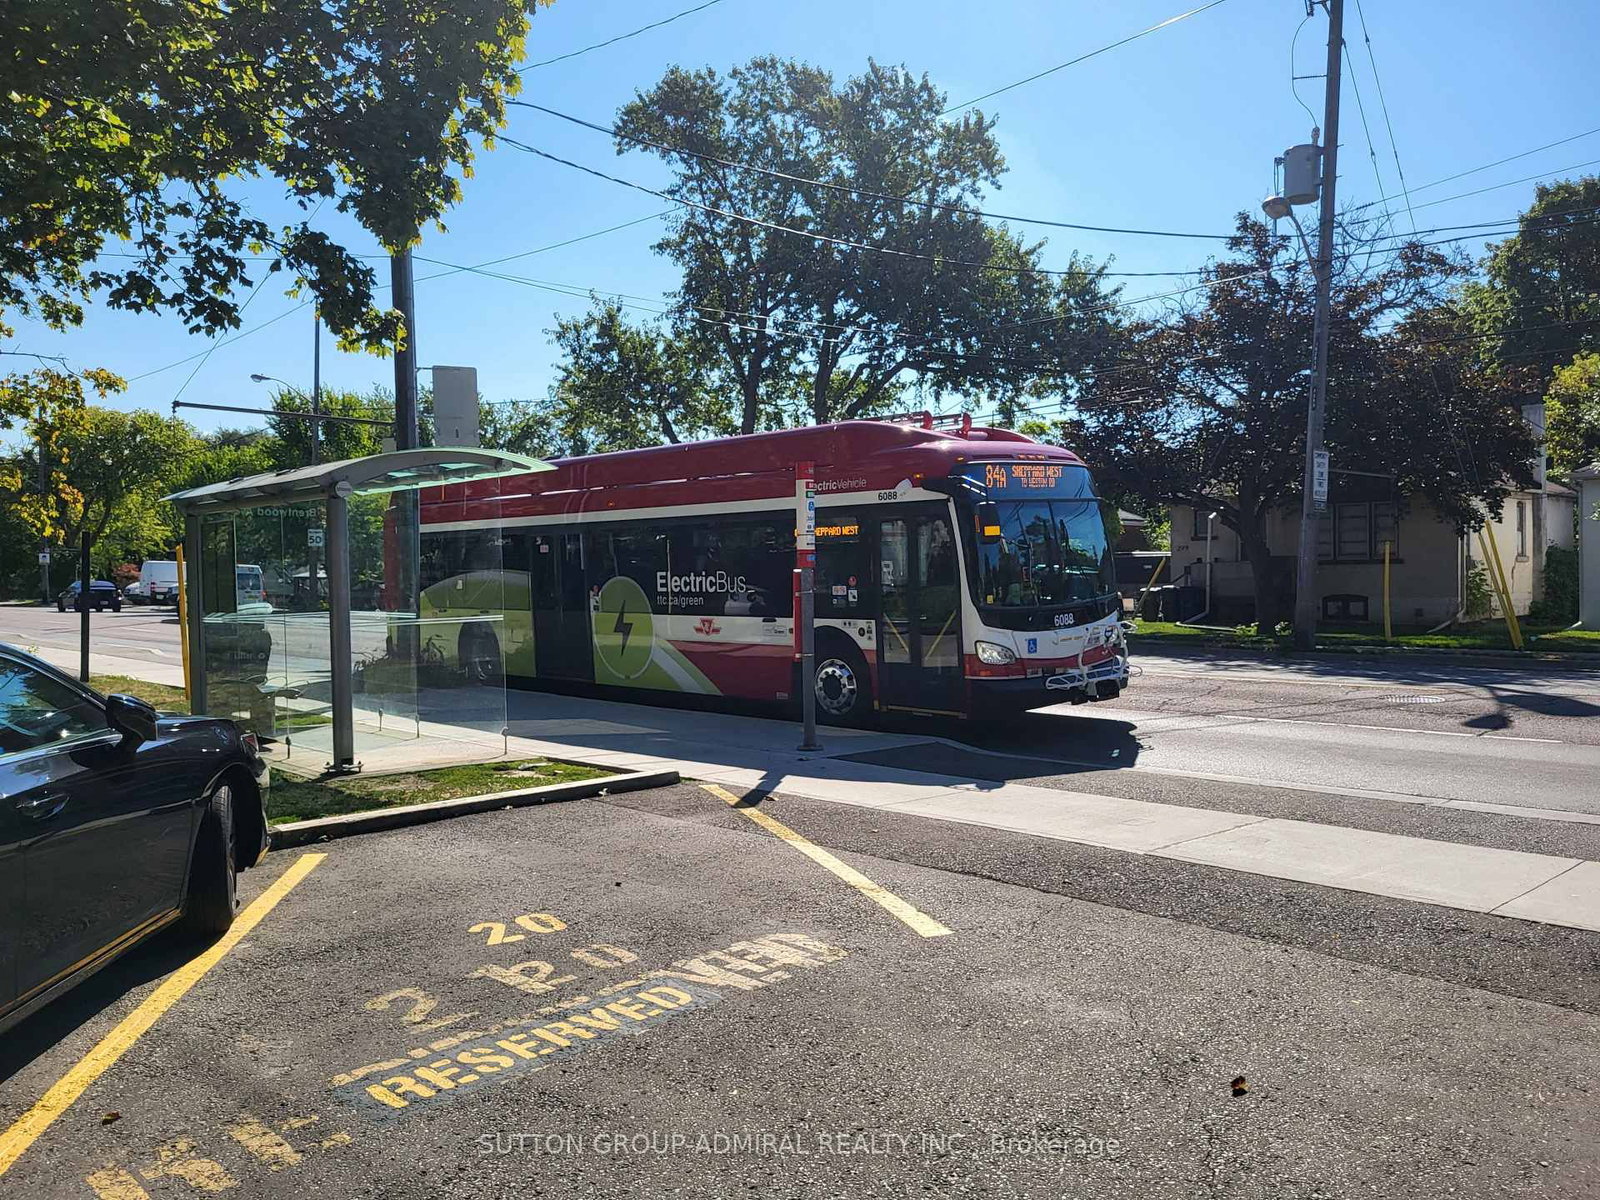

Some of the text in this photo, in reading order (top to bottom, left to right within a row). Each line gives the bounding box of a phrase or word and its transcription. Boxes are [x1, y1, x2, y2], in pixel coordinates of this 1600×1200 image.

[985, 464, 1063, 488] 84A SHEPPARD WEST
[813, 477, 867, 491] ectricVehicle
[878, 491, 898, 501] 6088
[842, 525, 859, 536] WEST
[309, 536, 322, 545] 50
[656, 570, 747, 593] ElectricBus
[656, 594, 704, 608] ttc.ca/green
[1054, 612, 1075, 627] 6088
[467, 912, 568, 946] 20
[365, 986, 693, 1108] RESERVED
